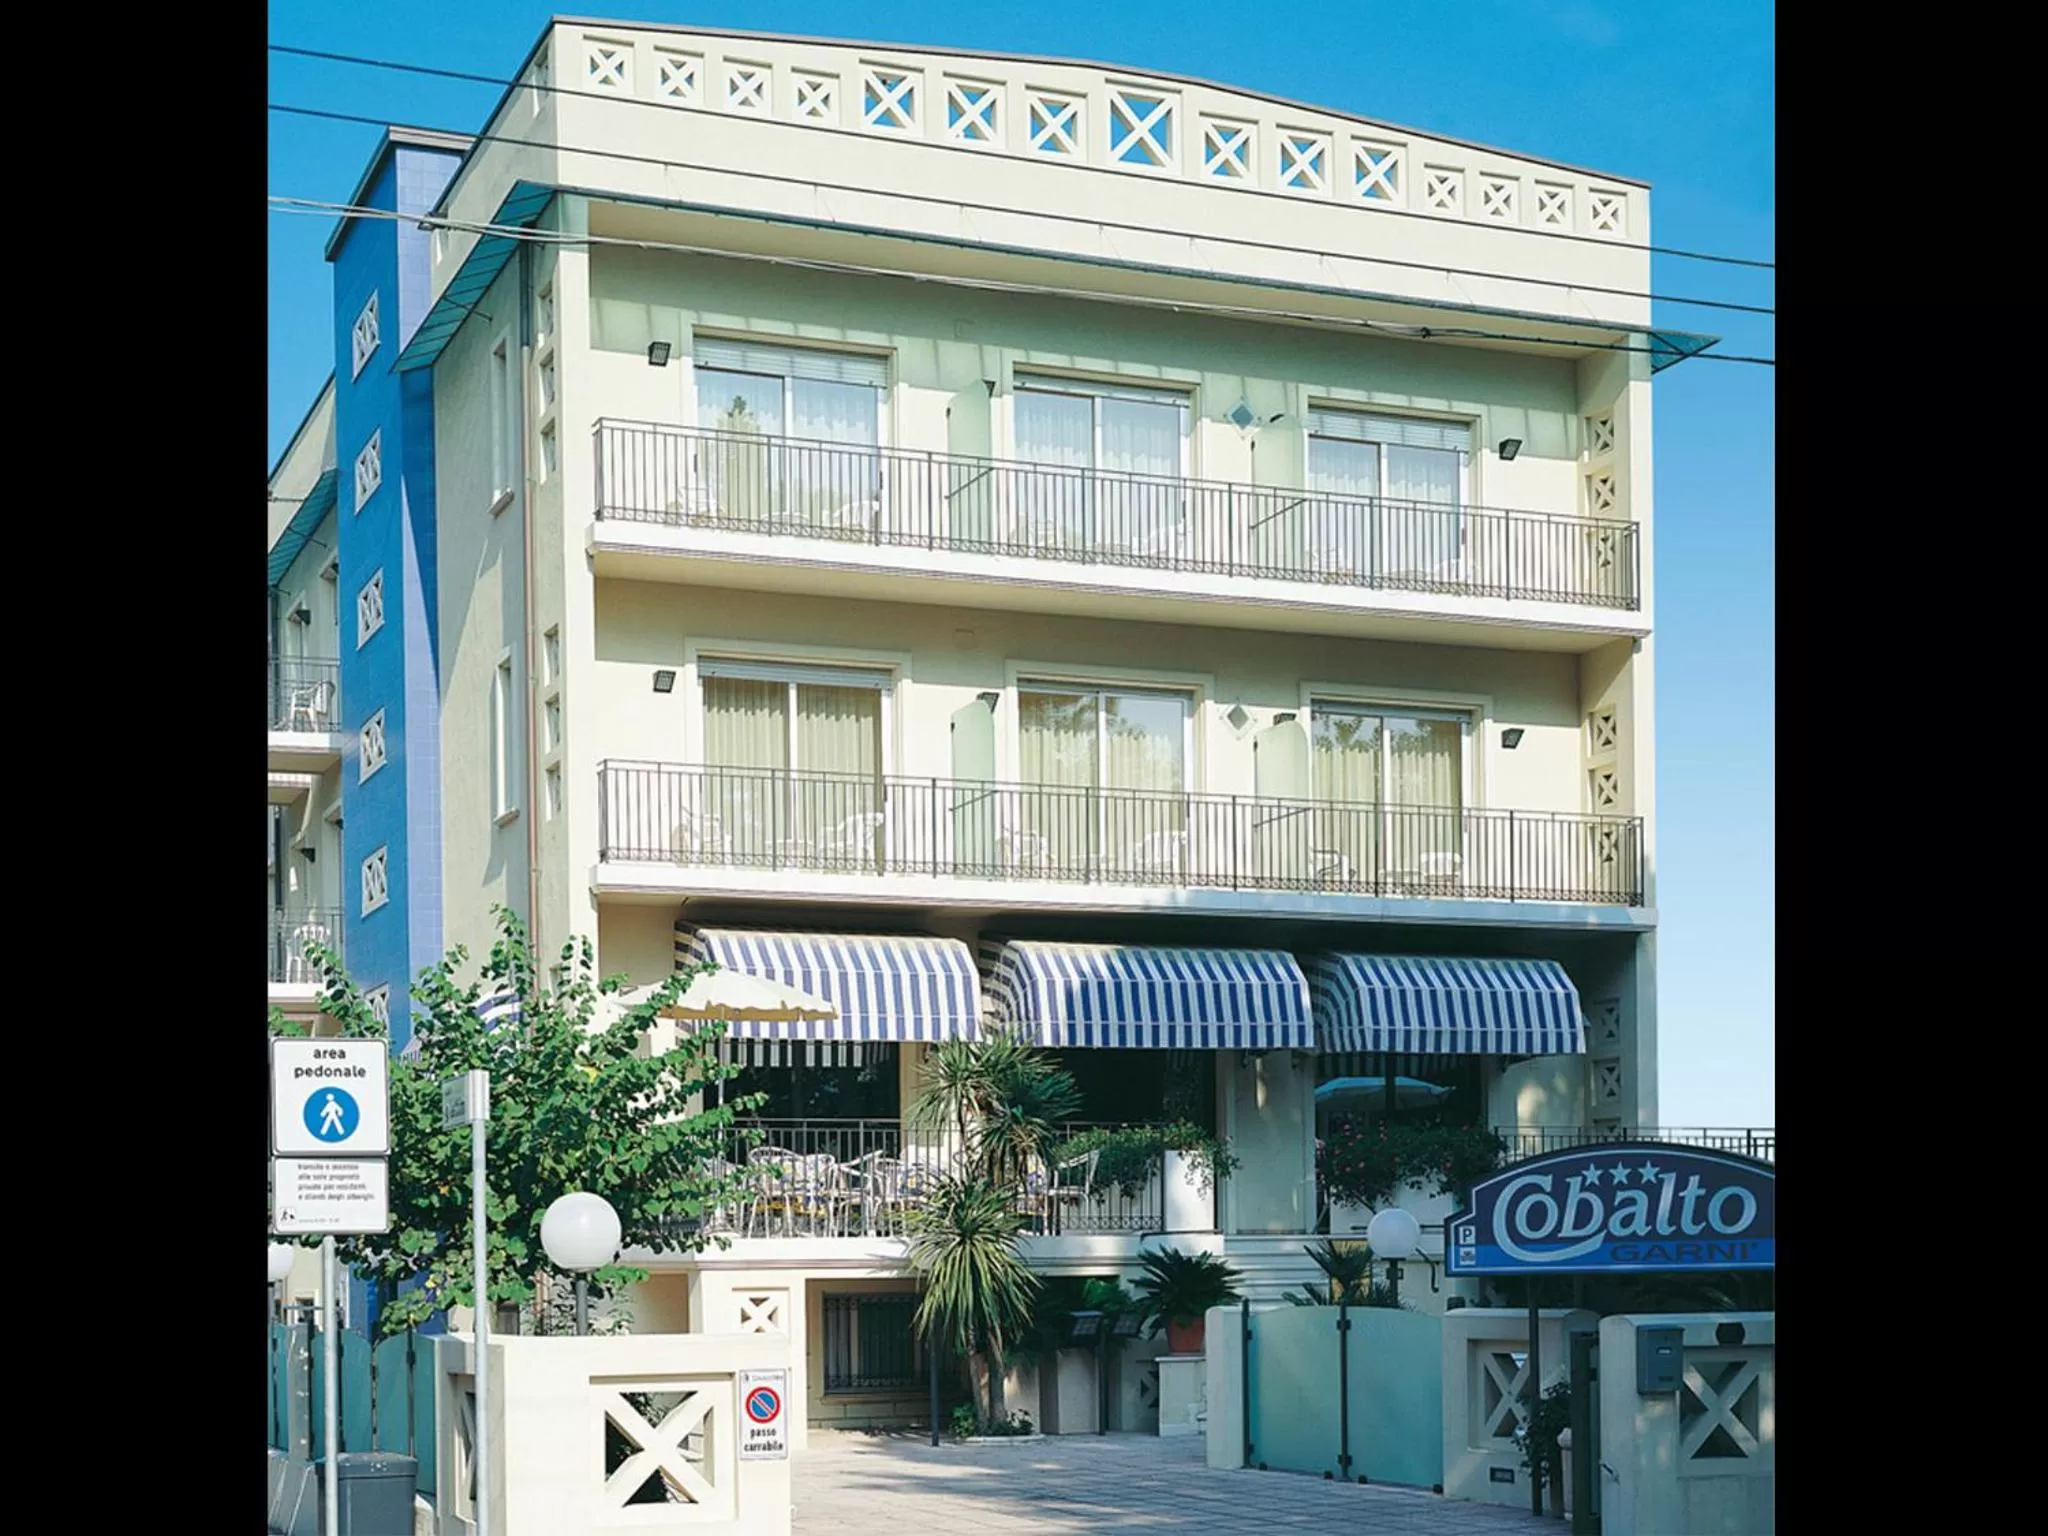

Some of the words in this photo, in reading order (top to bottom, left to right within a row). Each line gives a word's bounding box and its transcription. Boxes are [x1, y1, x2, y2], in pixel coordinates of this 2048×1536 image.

[313, 1049, 346, 1059] area
[294, 1065, 367, 1079] pedonale
[1493, 1173, 1757, 1262] Cobalto
[1462, 1228, 1472, 1243] P
[750, 1428, 777, 1439] passo
[744, 1441, 784, 1452] carrabile
